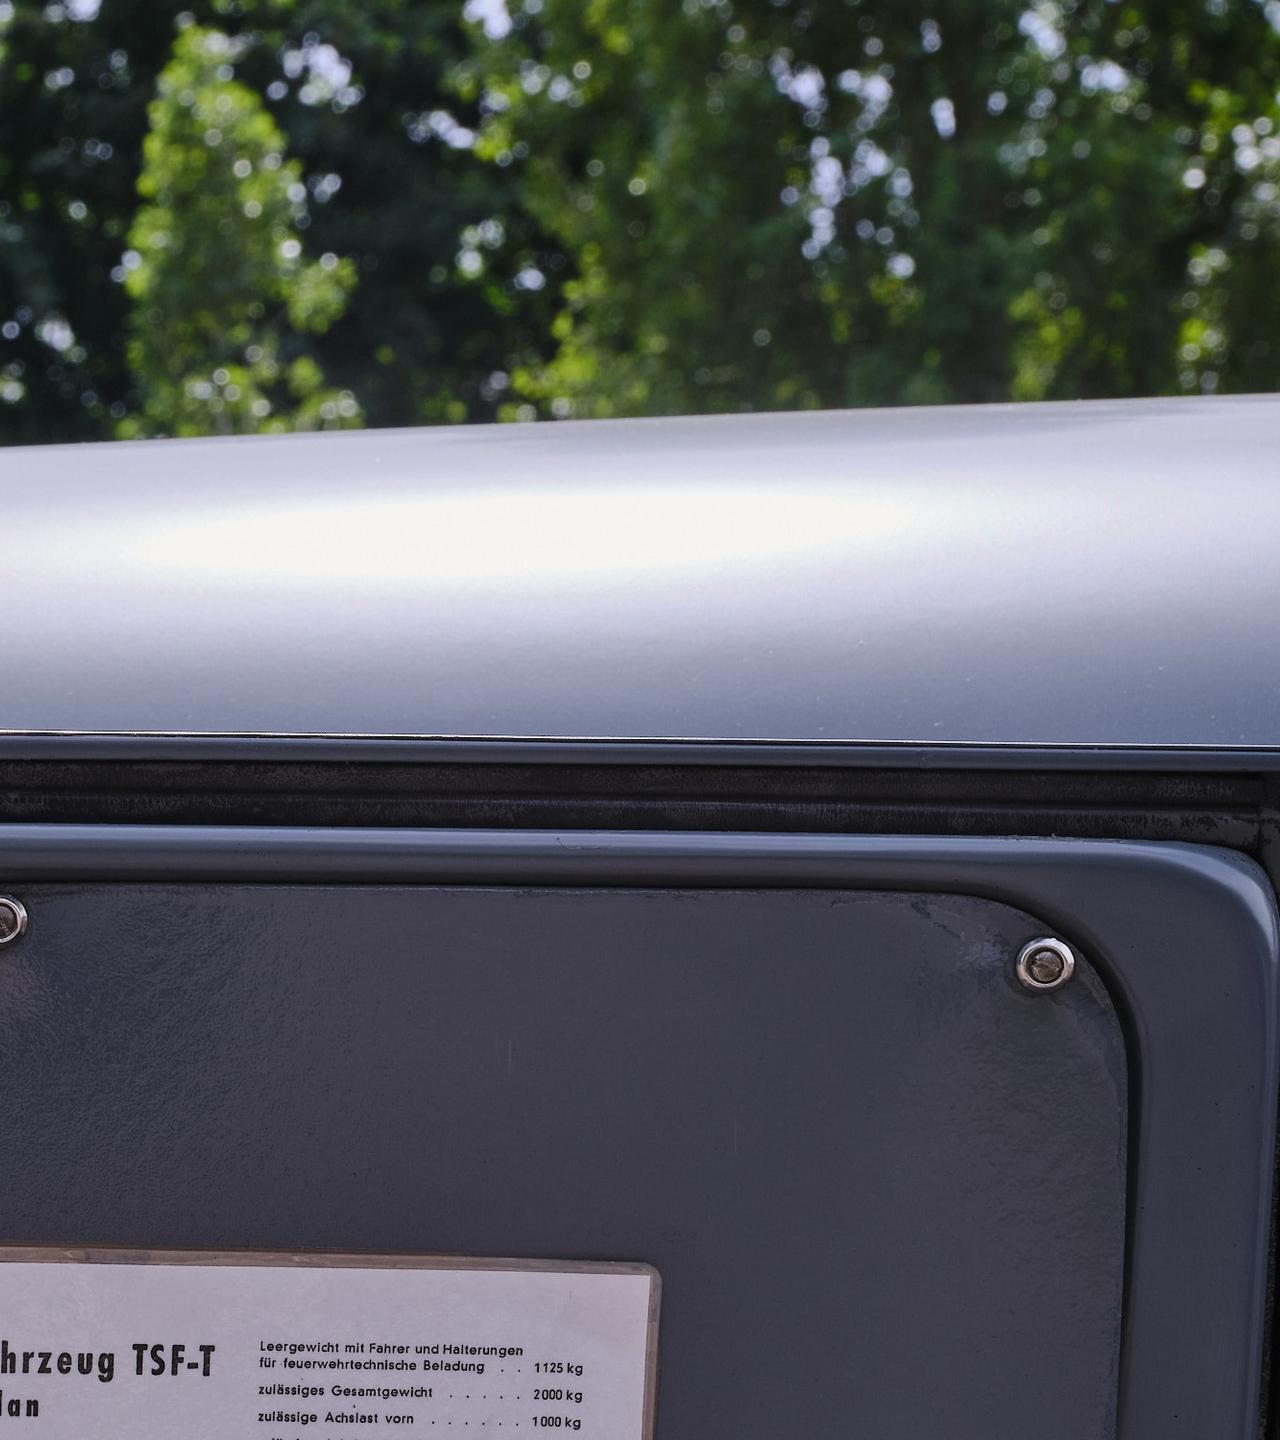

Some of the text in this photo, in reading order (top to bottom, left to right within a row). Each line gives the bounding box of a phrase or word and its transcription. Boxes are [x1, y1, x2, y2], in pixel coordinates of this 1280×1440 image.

[259, 1340, 524, 1359] Leergewicht mit Fahrer und Halterungen
[131, 1343, 216, 1377] TSF-T
[258, 1356, 485, 1375] für feuerwehrtechnische Beladung
[566, 1362, 584, 1377] kg
[258, 1383, 433, 1400] zulässiges Gesamtgewicht
[565, 1389, 583, 1404] kg
[257, 1410, 414, 1426] zulässige Achslast vorn
[564, 1416, 582, 1431] kg
